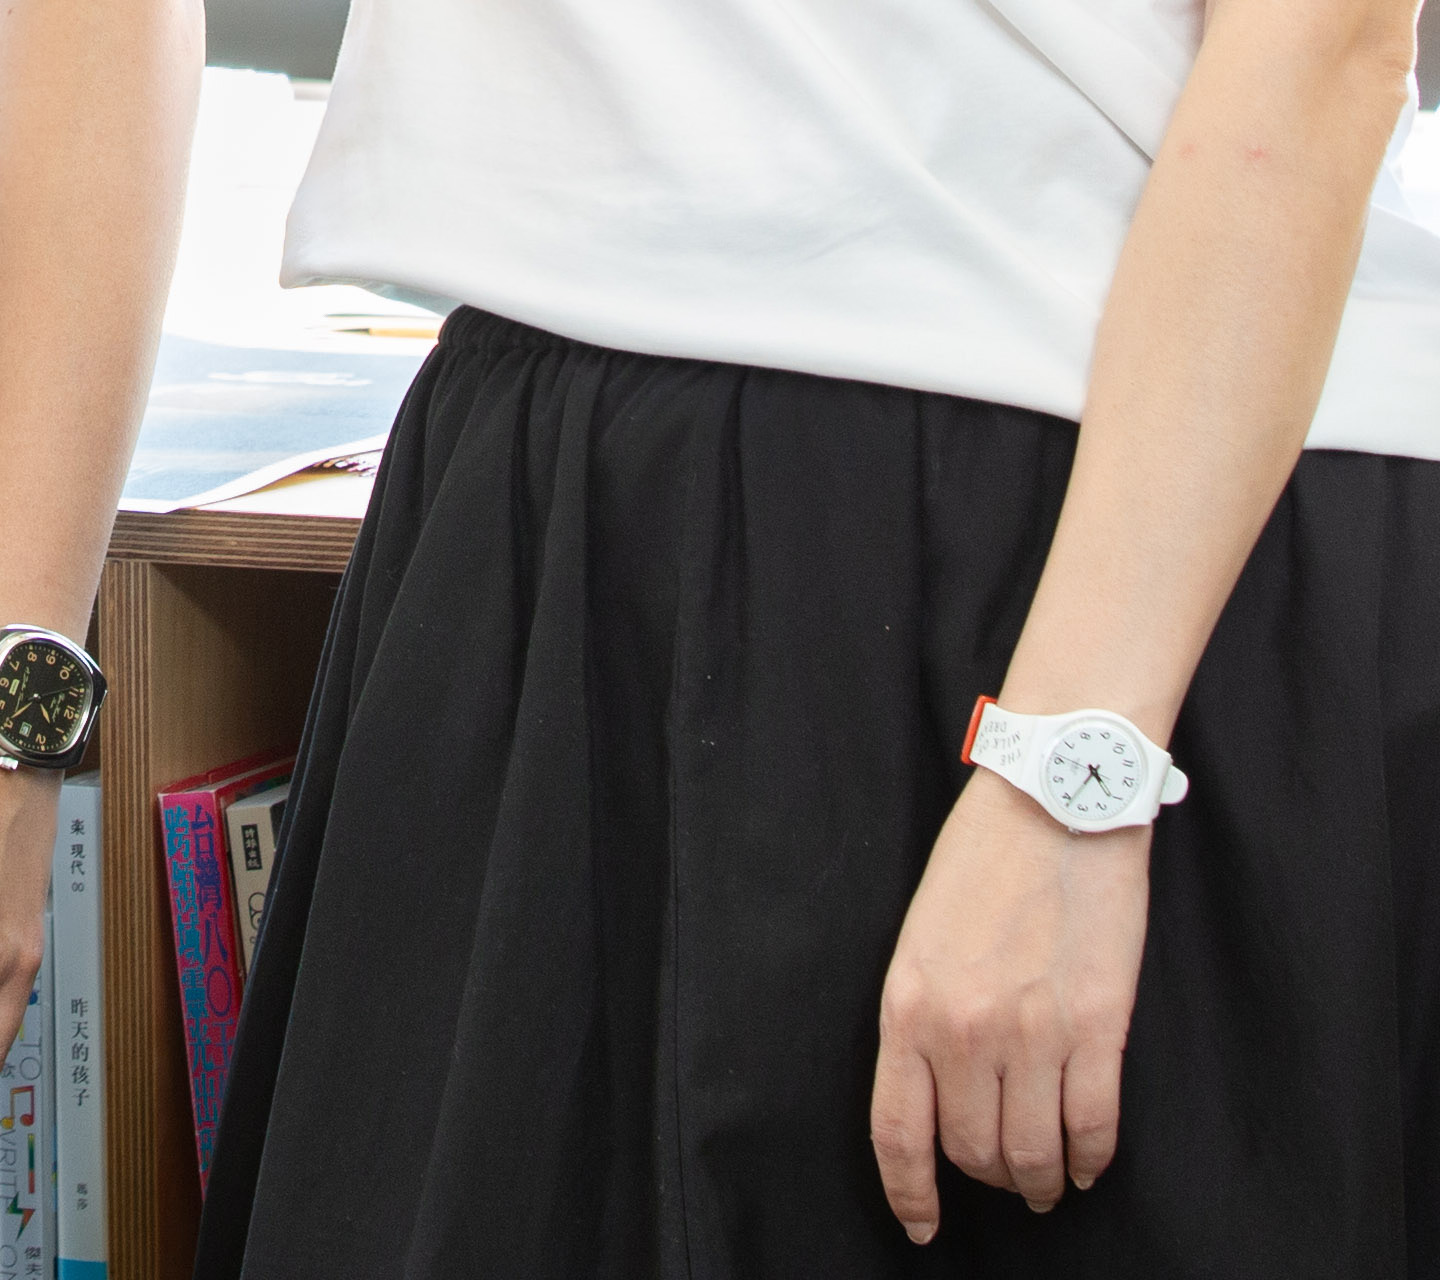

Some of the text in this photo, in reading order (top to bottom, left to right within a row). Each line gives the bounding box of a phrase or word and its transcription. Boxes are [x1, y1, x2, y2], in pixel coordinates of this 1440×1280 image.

[27, 651, 38, 662] 8
[45, 654, 56, 665] 9
[9, 660, 20, 671] 7
[60, 665, 71, 680] 10
[0, 677, 10, 688] 6
[68, 687, 79, 698] 11
[64, 705, 76, 720] 12
[35, 733, 46, 745] 2
[1079, 732, 1091, 741] 8
[1099, 731, 1111, 740] 9
[1063, 740, 1075, 750] 7
[1112, 742, 1126, 755] 10
[1053, 756, 1065, 765] 6
[1122, 758, 1135, 768] 11
[1052, 775, 1065, 784] 5
[1121, 775, 1135, 788] 12
[1061, 792, 1072, 801] 4
[1077, 803, 1089, 813] 3
[1095, 801, 1107, 811] 2
[70, 998, 89, 1107] 昨天的孩子
